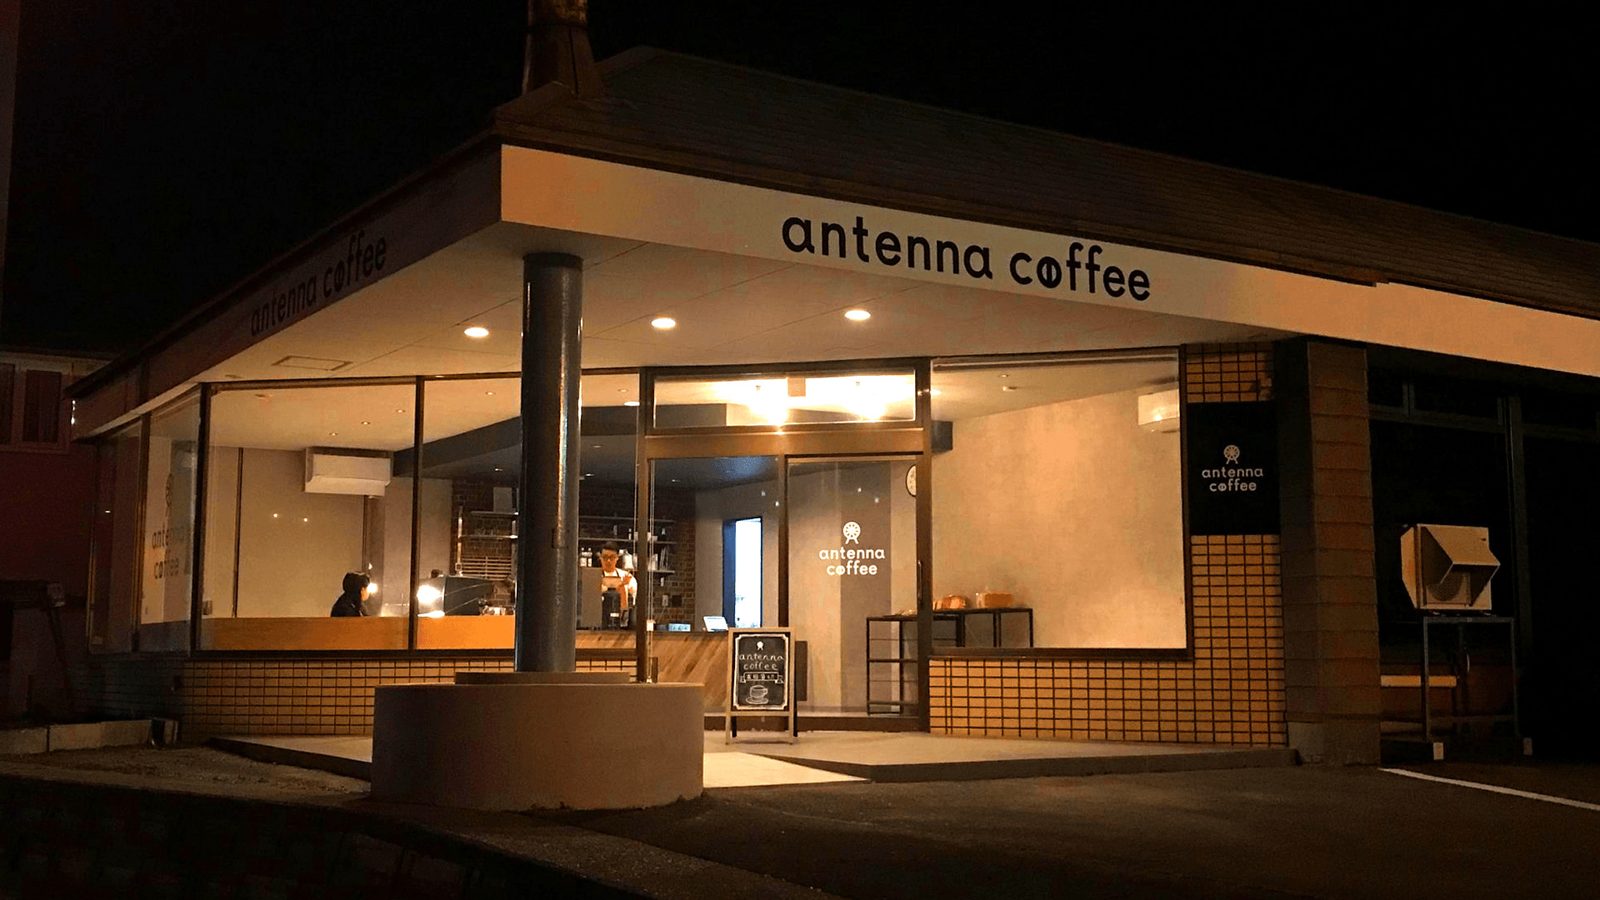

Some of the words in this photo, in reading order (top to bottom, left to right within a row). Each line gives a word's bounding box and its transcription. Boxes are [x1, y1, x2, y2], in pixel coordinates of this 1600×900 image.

[782, 216, 993, 279] antenna
[1010, 242, 1150, 301] coffee
[250, 275, 317, 337] antenna
[323, 229, 387, 298] coffee
[1201, 466, 1264, 479] antenna
[1208, 478, 1257, 492] coffee
[819, 546, 886, 560] antenna
[826, 560, 878, 576] coffee
[738, 652, 785, 661] antenna
[743, 661, 779, 671] coffee
